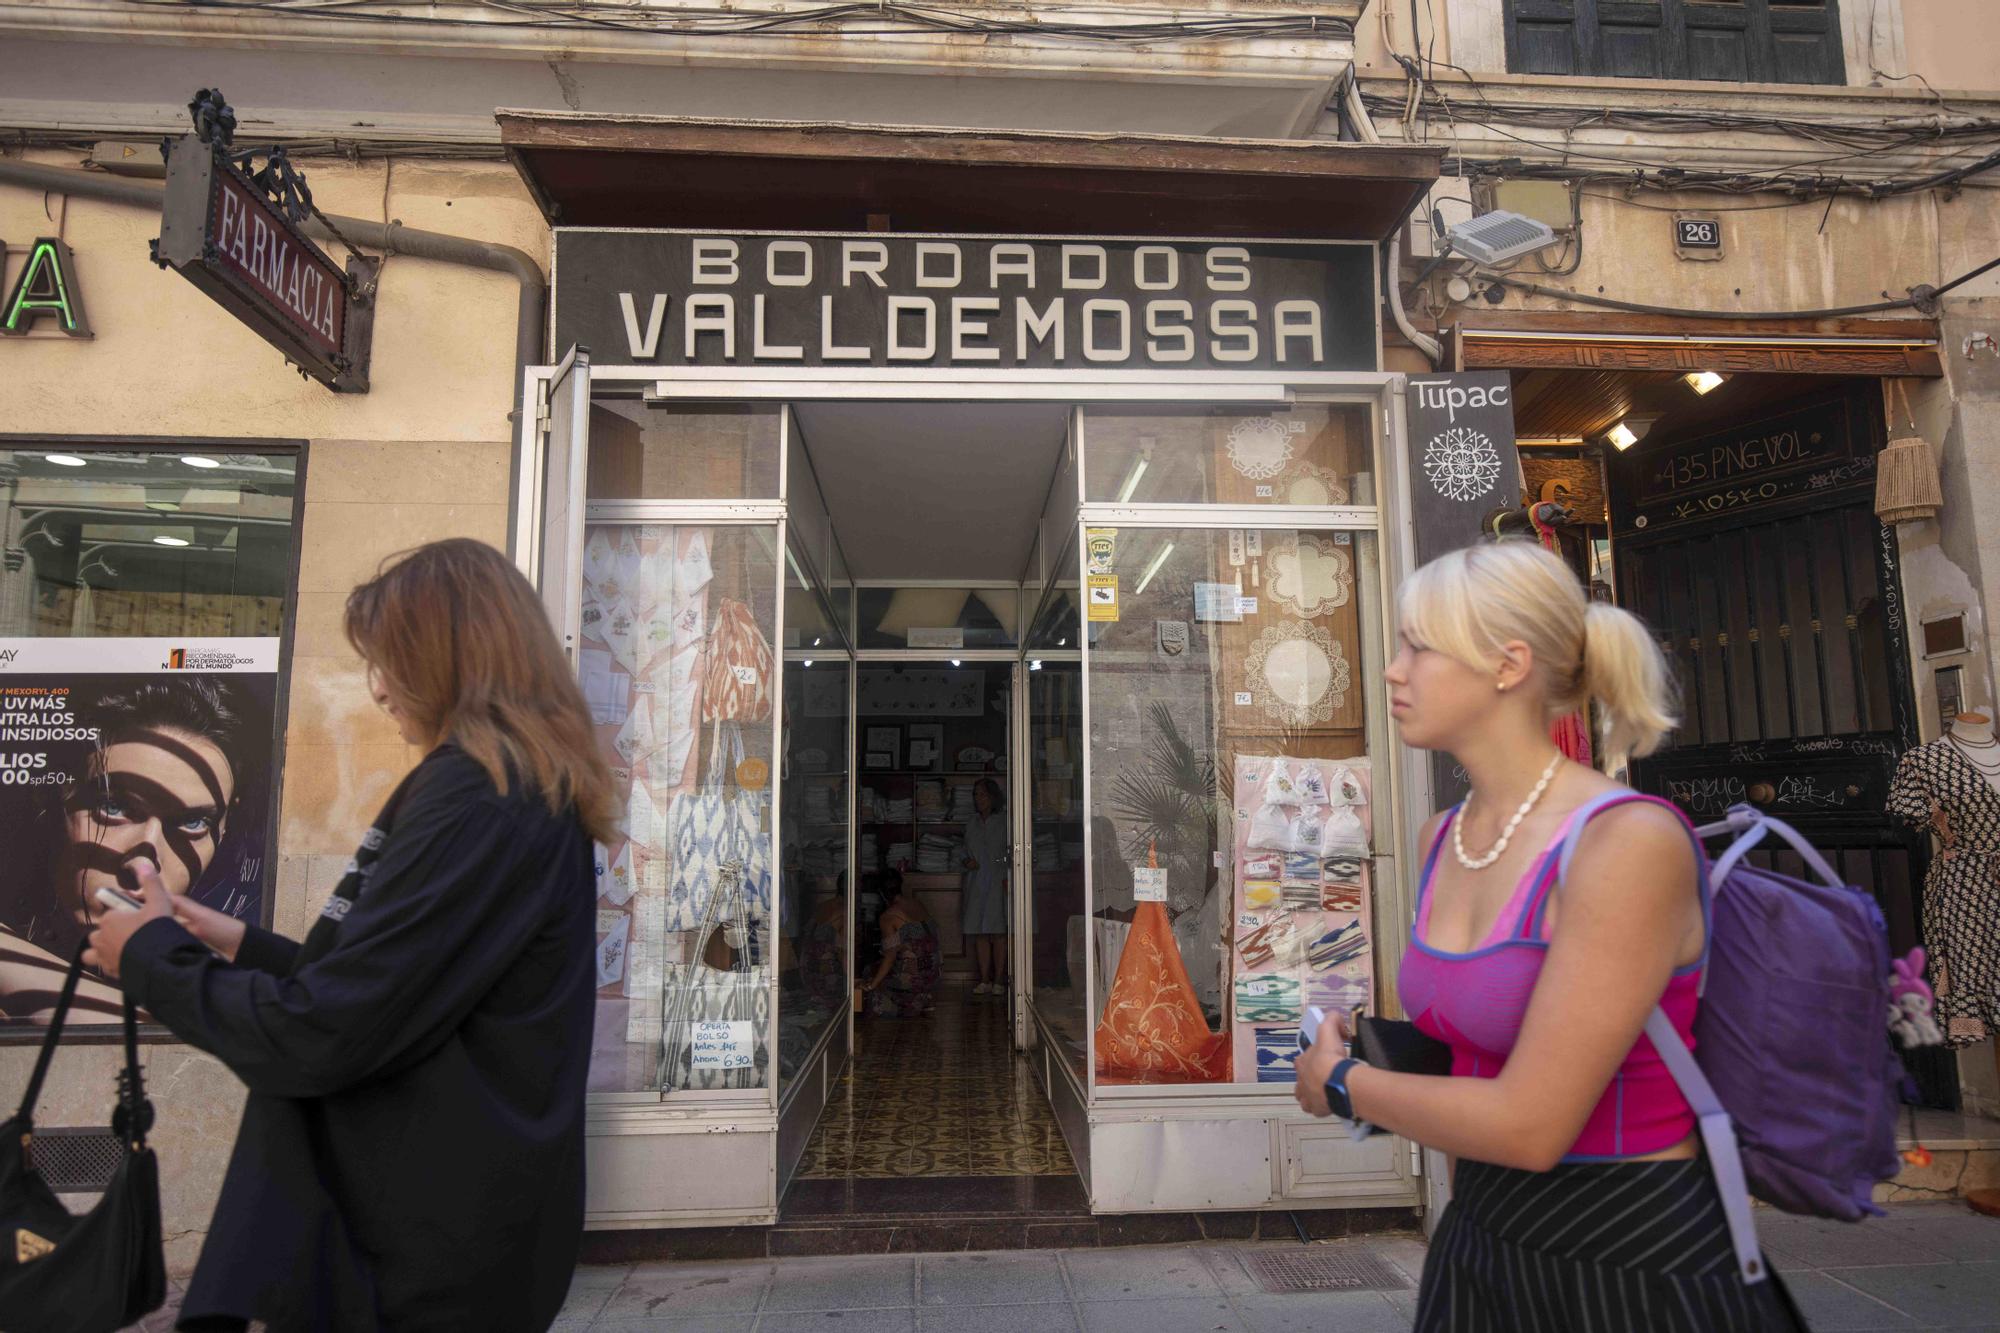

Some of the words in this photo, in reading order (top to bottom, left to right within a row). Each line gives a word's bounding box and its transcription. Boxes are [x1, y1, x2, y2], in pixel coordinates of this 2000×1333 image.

[1685, 223, 1712, 241] 26
[219, 184, 337, 343] FARMACIA
[692, 238, 1252, 291] BORDADOS
[619, 292, 1325, 363] VALLDEMOSSA
[1409, 380, 1508, 424] Tupac
[5, 687, 49, 695] MEXORYL
[51, 687, 70, 695] 400
[4, 697, 28, 709] UV
[30, 694, 66, 710] MÁS
[42, 712, 75, 725] LOS
[696, 1032, 729, 1040] BOLSO
